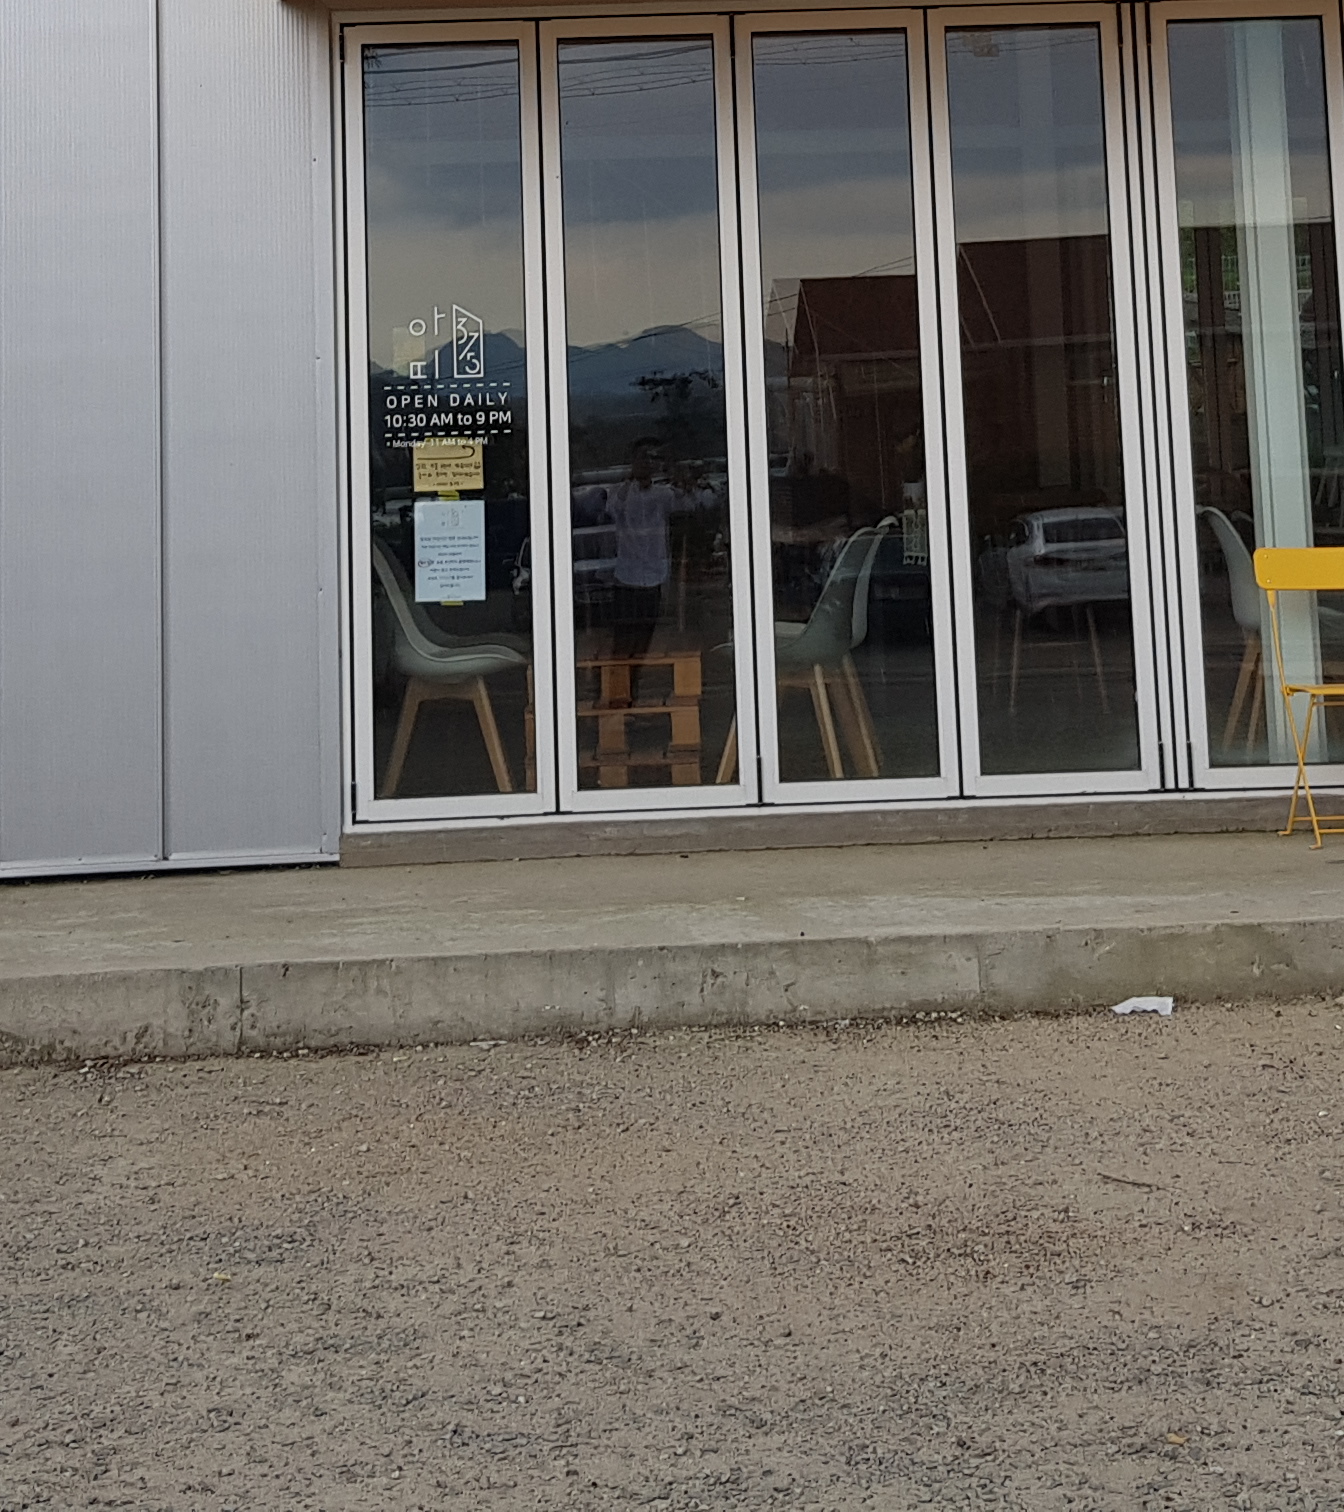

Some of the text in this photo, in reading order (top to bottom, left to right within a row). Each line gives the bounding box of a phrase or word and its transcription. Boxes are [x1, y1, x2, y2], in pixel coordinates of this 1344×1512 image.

[386, 391, 508, 408] OPEN DAILY
[384, 410, 512, 428] 10:30 AM to 9 PM
[392, 439, 426, 448] Monday
